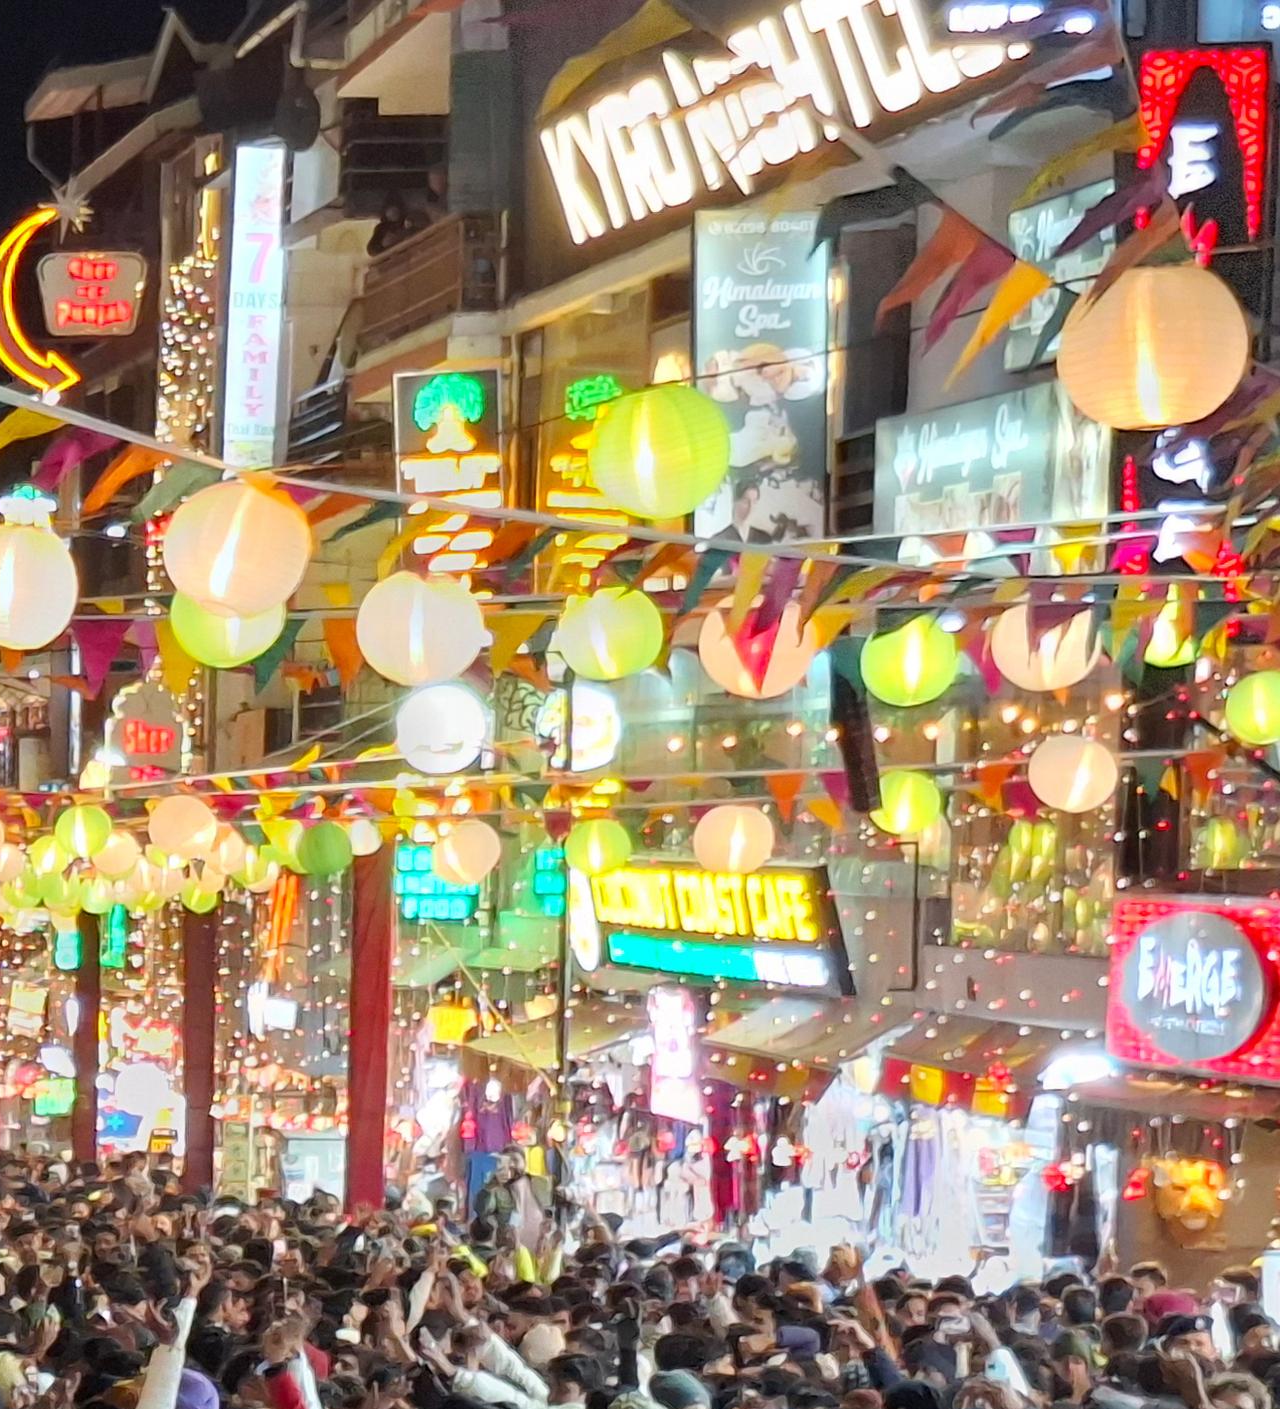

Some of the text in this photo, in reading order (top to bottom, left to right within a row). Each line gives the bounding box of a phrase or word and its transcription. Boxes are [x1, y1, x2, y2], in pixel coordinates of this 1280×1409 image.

[540, 78, 697, 245] KYRO
[246, 233, 273, 284] 7
[233, 291, 278, 308] DAYS
[703, 275, 823, 309] Himalayan
[735, 304, 791, 338] Spa
[242, 314, 269, 417] FAMILY
[746, 872, 819, 942] CAFE
